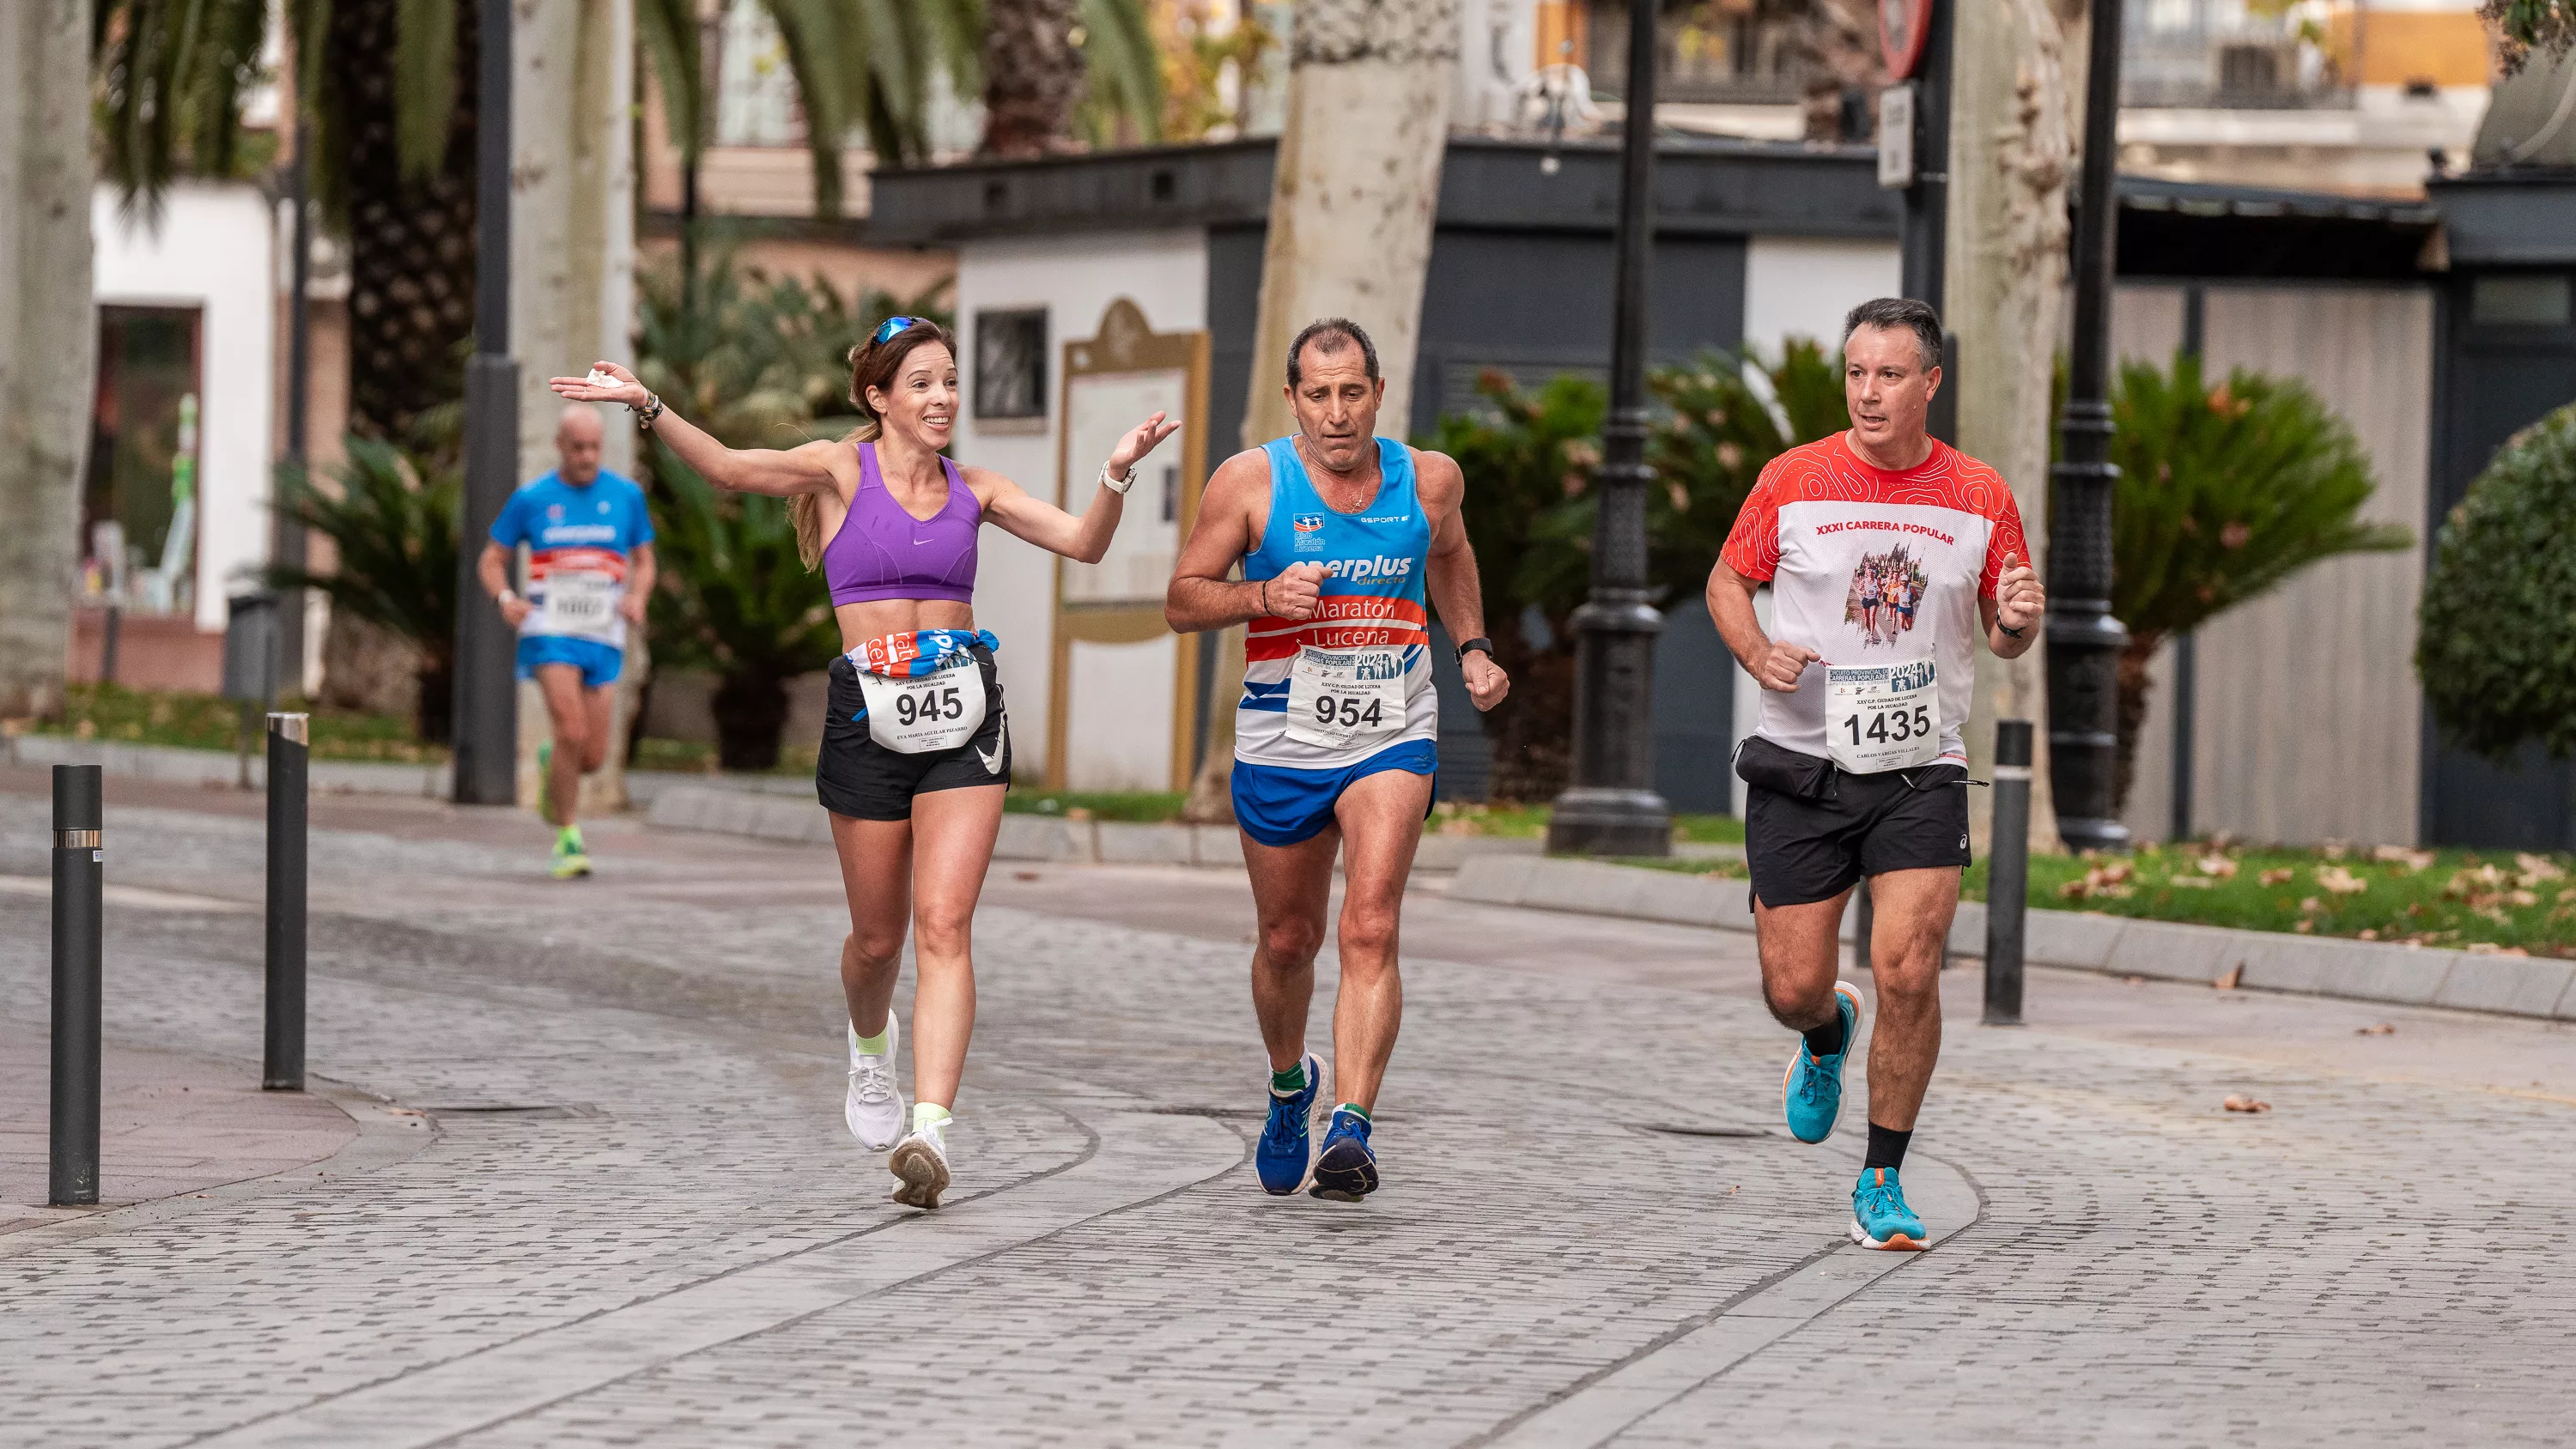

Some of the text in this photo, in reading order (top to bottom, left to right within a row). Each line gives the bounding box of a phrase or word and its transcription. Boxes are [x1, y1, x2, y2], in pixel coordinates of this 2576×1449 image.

[1294, 537, 1326, 546] Maratón
[1815, 520, 1955, 546] XXXI CARRERA POPULAR
[1290, 555, 1413, 582] erplus
[1357, 576, 1406, 585] directo
[1309, 597, 1395, 620] Maratón
[1313, 629, 1389, 647] Lucena
[1357, 654, 1383, 667] 2024
[1890, 664, 1918, 679] 2024
[896, 687, 963, 726] 945
[1315, 695, 1382, 727] 954
[1844, 704, 1931, 746] 1435
